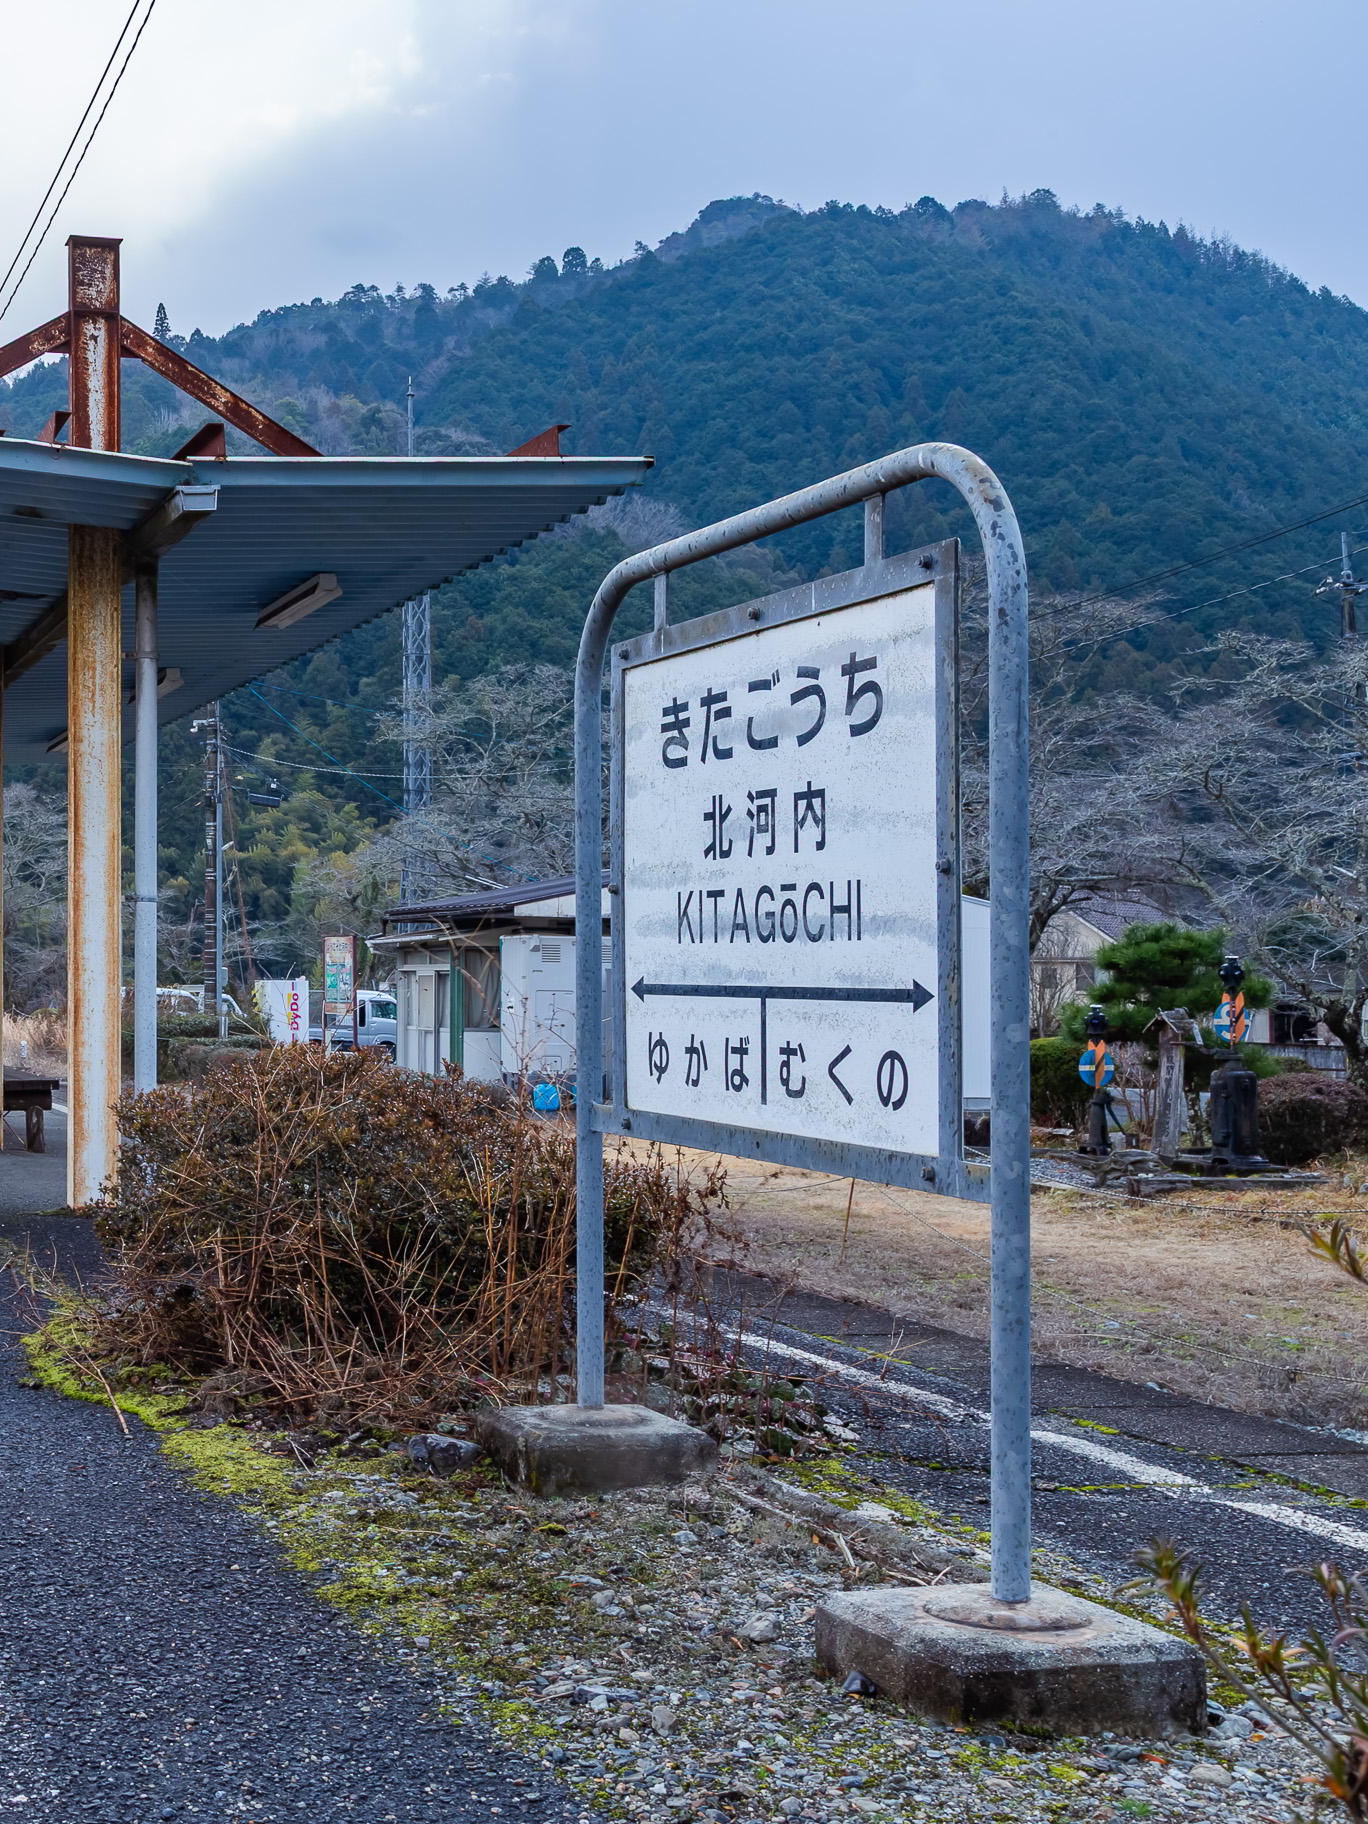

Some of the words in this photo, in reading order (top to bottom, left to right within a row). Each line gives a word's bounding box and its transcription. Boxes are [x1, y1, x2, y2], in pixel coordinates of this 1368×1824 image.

[660, 651, 883, 769] きたごうち
[703, 780, 826, 861] 北河内
[648, 1031, 750, 1092] ゆかば
[779, 1040, 909, 1112] むくの
